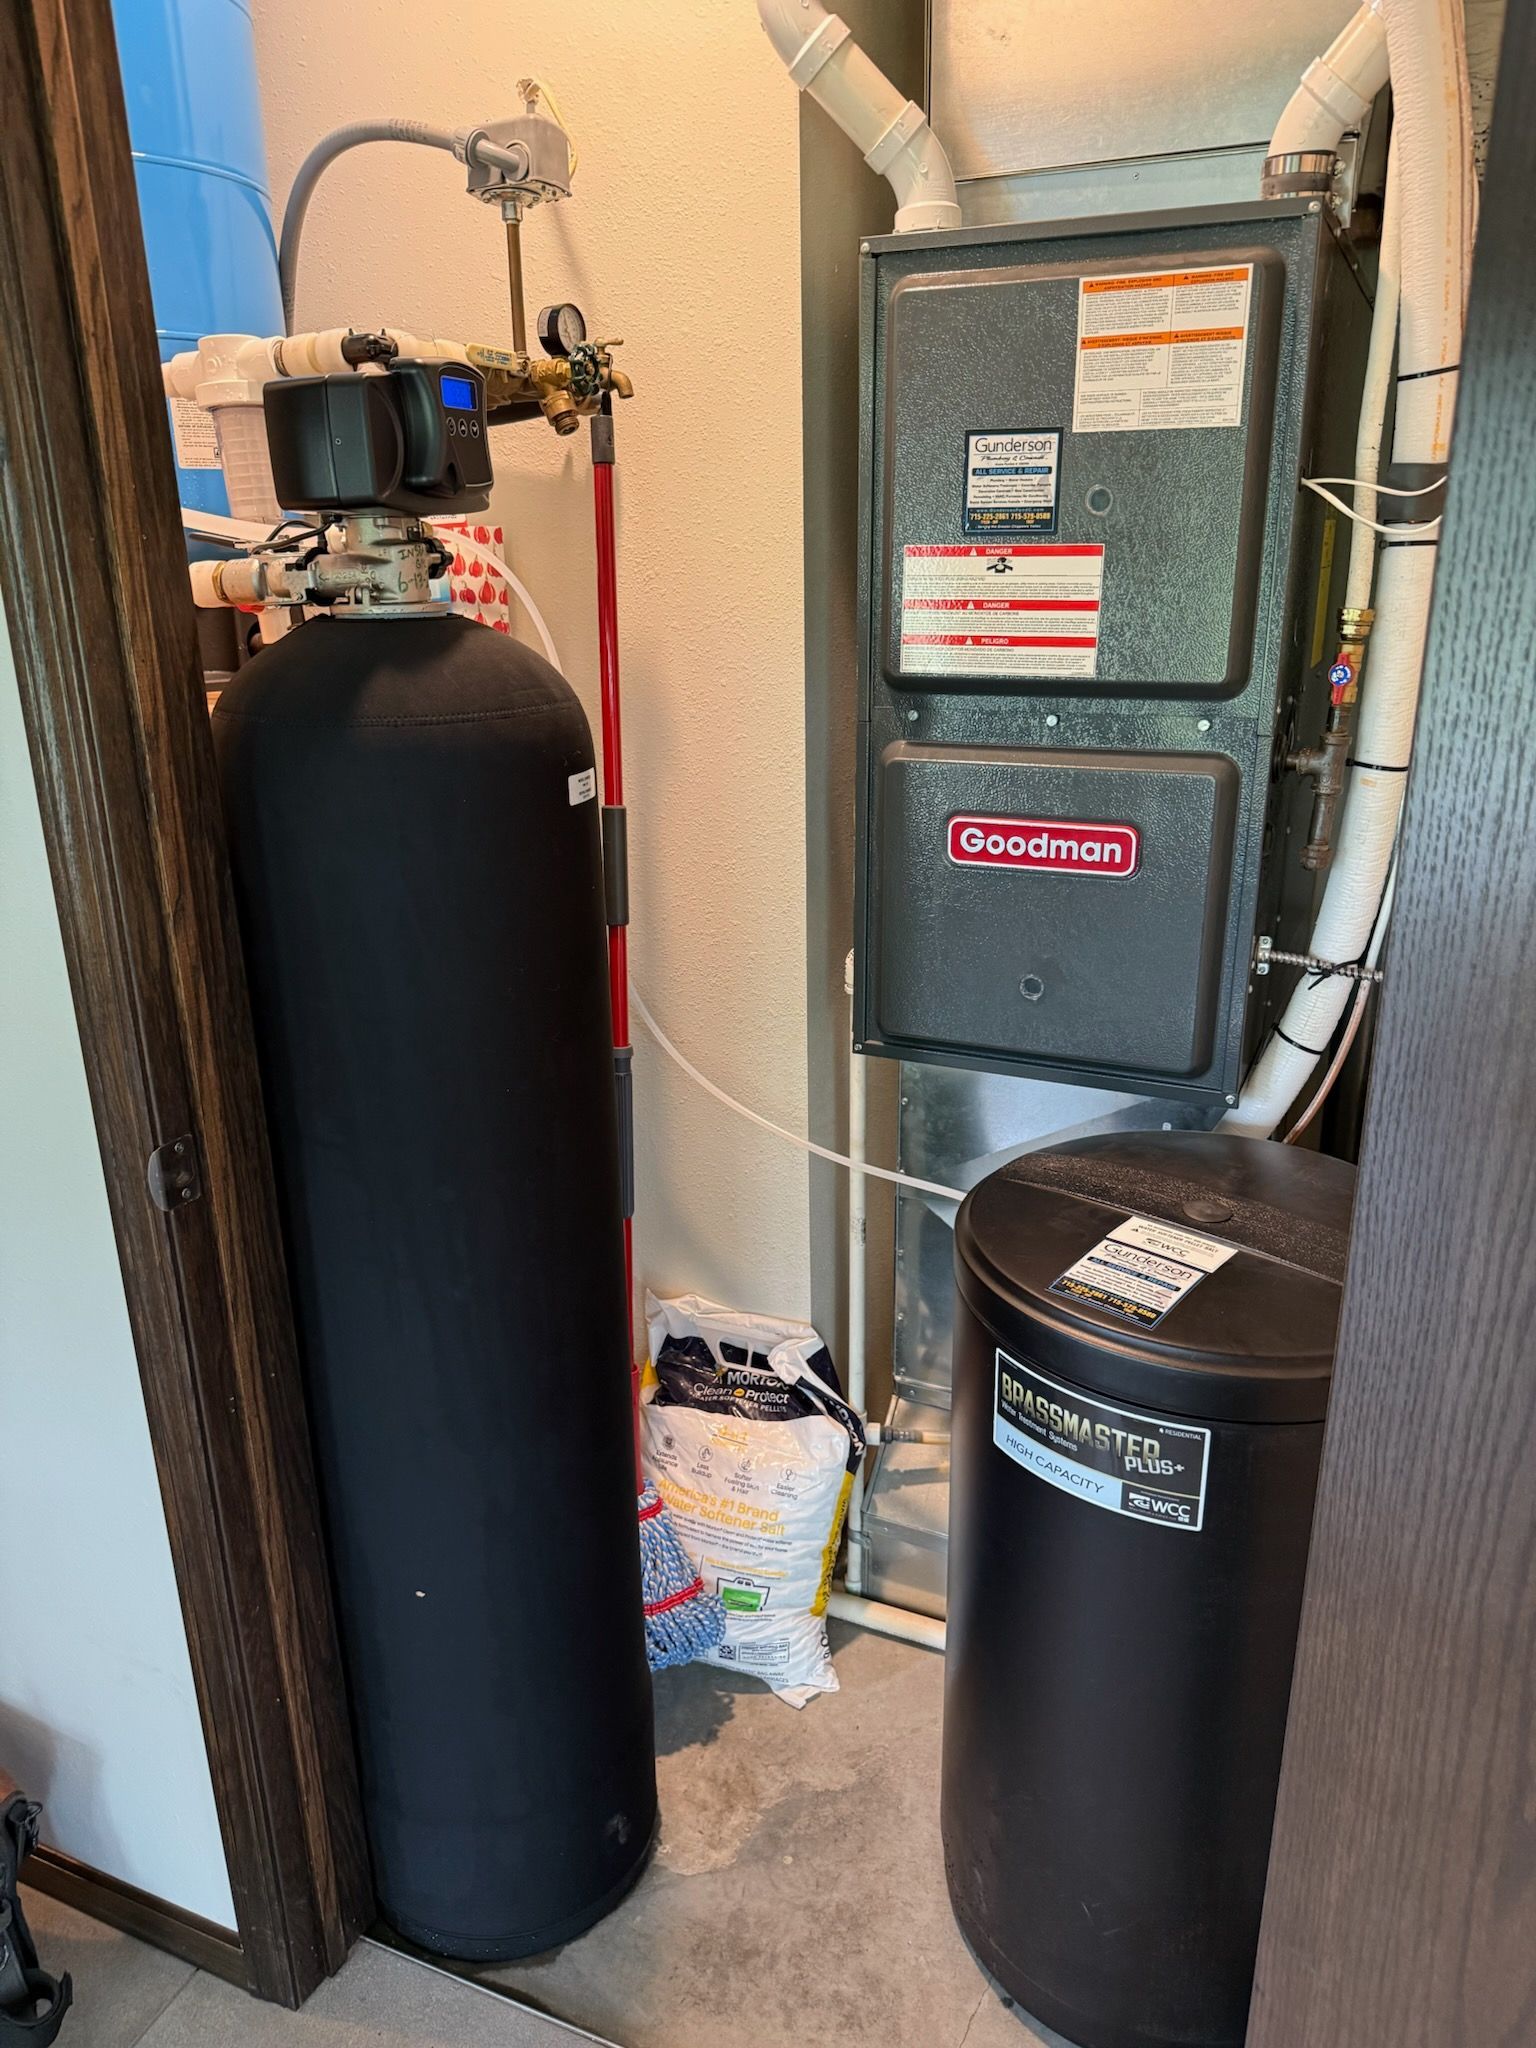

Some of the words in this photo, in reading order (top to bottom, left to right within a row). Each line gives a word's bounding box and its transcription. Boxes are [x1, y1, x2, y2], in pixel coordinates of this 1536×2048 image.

[975, 437, 1052, 452] Gunderson
[986, 548, 1012, 556] DANGER
[981, 638, 1009, 646] PELIGRO
[960, 828, 1122, 863] Goodman
[1160, 1242, 1190, 1256] WCC
[1104, 1244, 1192, 1279] Gunderson
[728, 1372, 790, 1391] MORTON
[694, 1382, 732, 1396] Clean
[744, 1389, 790, 1404] Protect
[1000, 1400, 1017, 1418] Water
[1018, 1412, 1048, 1436] Treatment
[1048, 1431, 1078, 1452] Systems
[1002, 1372, 1160, 1463] BRASSMASTER
[1124, 1456, 1185, 1476] PLUS+
[1166, 1428, 1202, 1440] RESIDENTIAL
[696, 1462, 710, 1472] Less
[1006, 1434, 1034, 1460] HIGH
[1036, 1456, 1104, 1494] CAPACITY
[690, 1468, 712, 1479] Buildup
[734, 1472, 753, 1482] Softer
[770, 1488, 798, 1500] Cleaning
[776, 1482, 796, 1492] Easier
[658, 1479, 716, 1506] America's
[720, 1499, 734, 1512] #1
[738, 1502, 780, 1522] Brand
[1150, 1499, 1190, 1518] WCC
[664, 1494, 698, 1514] Water
[700, 1504, 758, 1530] Softener
[760, 1522, 785, 1536] Salt
